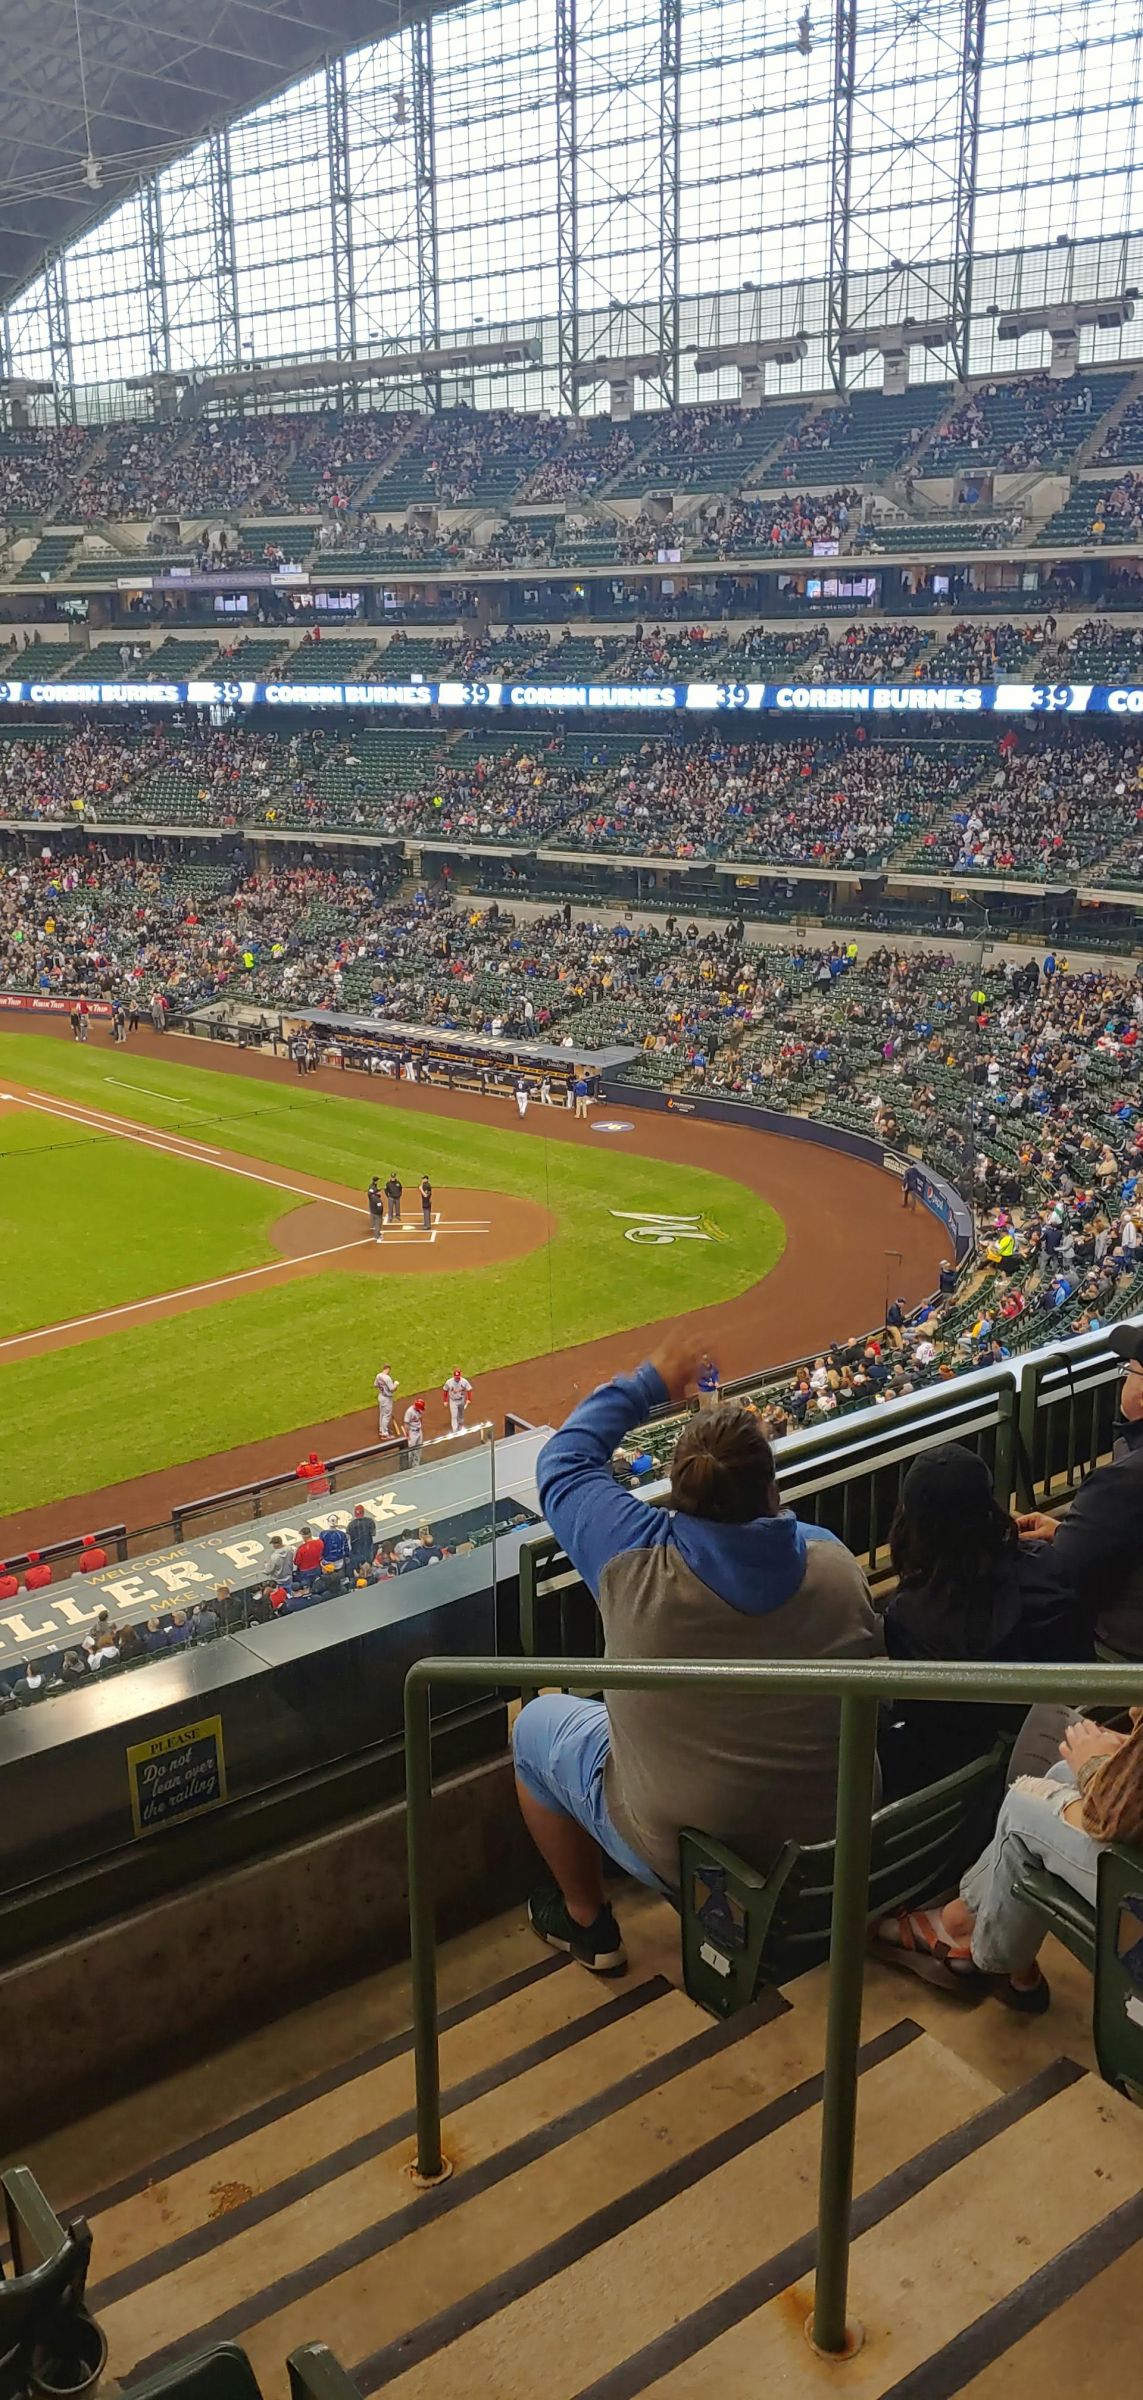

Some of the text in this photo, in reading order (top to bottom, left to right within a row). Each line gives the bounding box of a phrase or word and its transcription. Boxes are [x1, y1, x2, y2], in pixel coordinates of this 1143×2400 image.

[31, 685, 179, 702] CORBIN BURNES
[213, 682, 243, 702] 39
[265, 686, 431, 704] CORBIN BURNES
[461, 683, 490, 704] 39
[511, 687, 676, 706] CORBIN BURNES
[716, 684, 750, 708] 39
[777, 688, 982, 709] CORBIN BURNES
[1030, 684, 1074, 710] 39
[84, 1538, 223, 1586] WELCOME TO
[206, 1578, 236, 1593] WI
[150, 1728, 200, 1754] PLEASE
[143, 1747, 193, 1785] Do not
[152, 1758, 214, 1797] lean over
[143, 1775, 216, 1820] the railing
